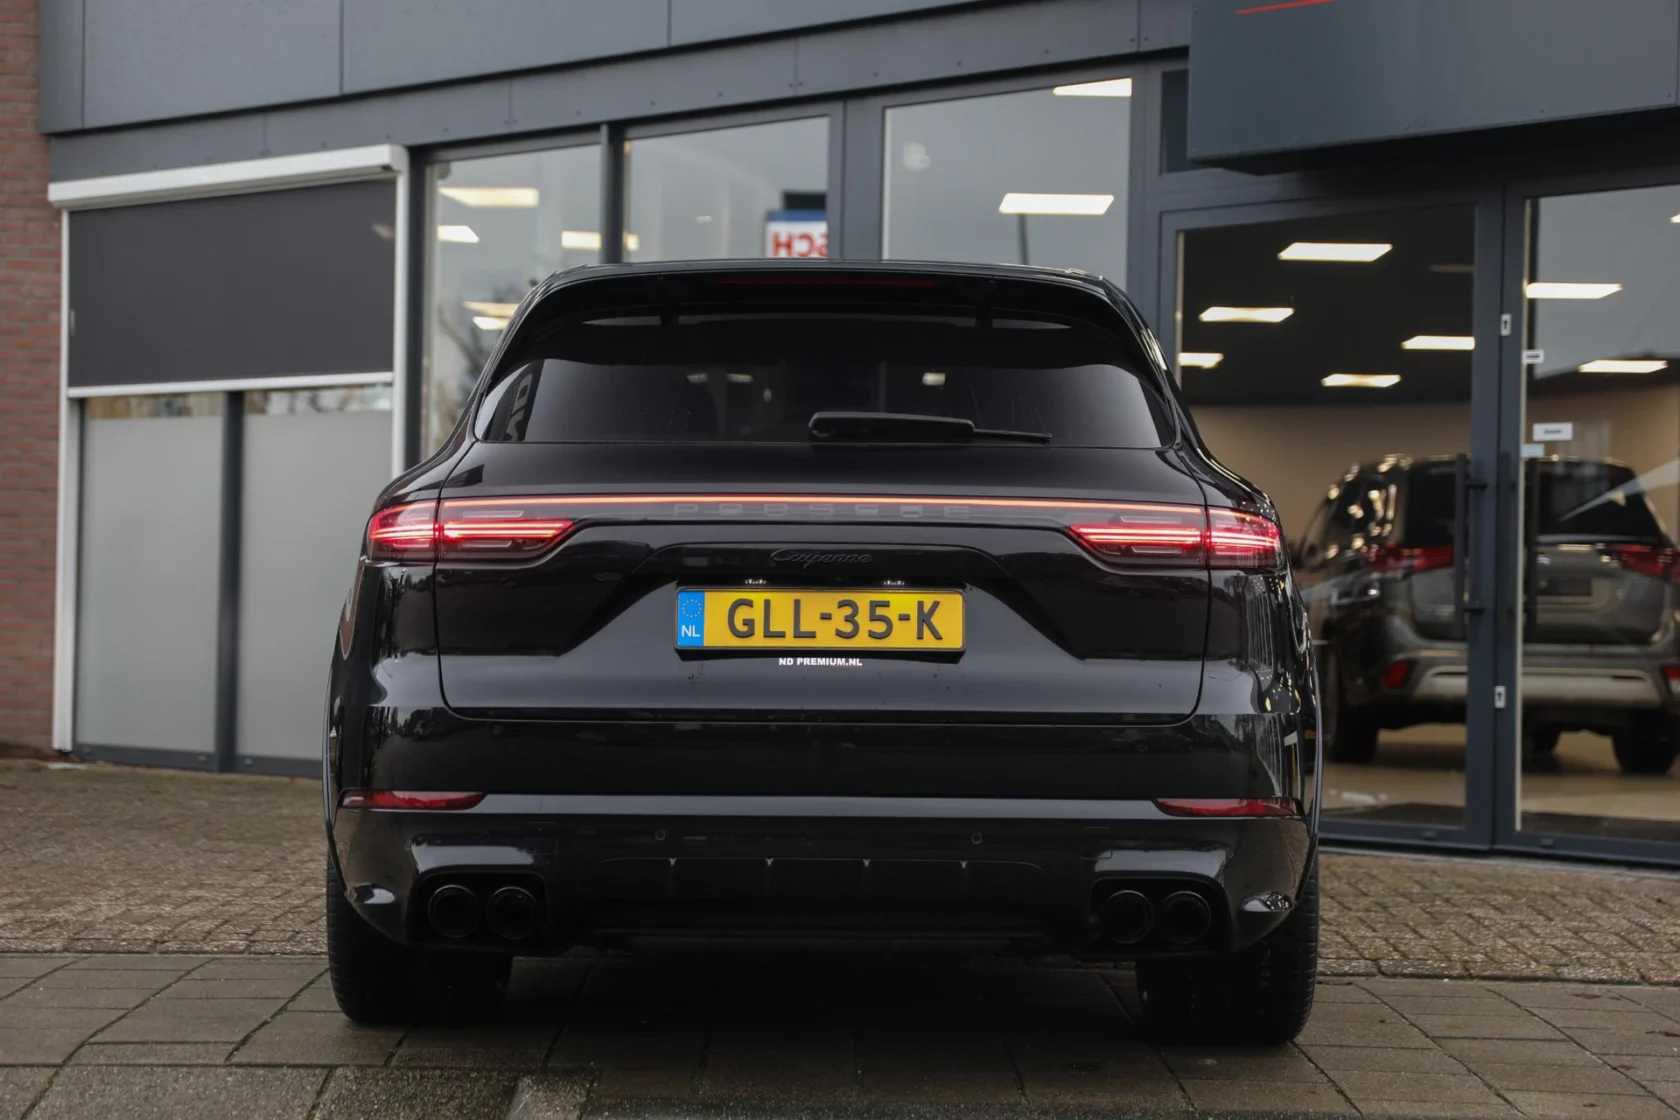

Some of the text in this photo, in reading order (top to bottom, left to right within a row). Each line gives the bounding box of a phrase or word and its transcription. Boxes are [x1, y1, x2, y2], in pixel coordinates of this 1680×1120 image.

[674, 503, 970, 517] PORSCHE
[770, 548, 873, 568] Cayenne
[727, 598, 943, 640] GLL-35-K
[681, 625, 700, 638] NL
[778, 657, 863, 667] ND PREMIUM.NL
